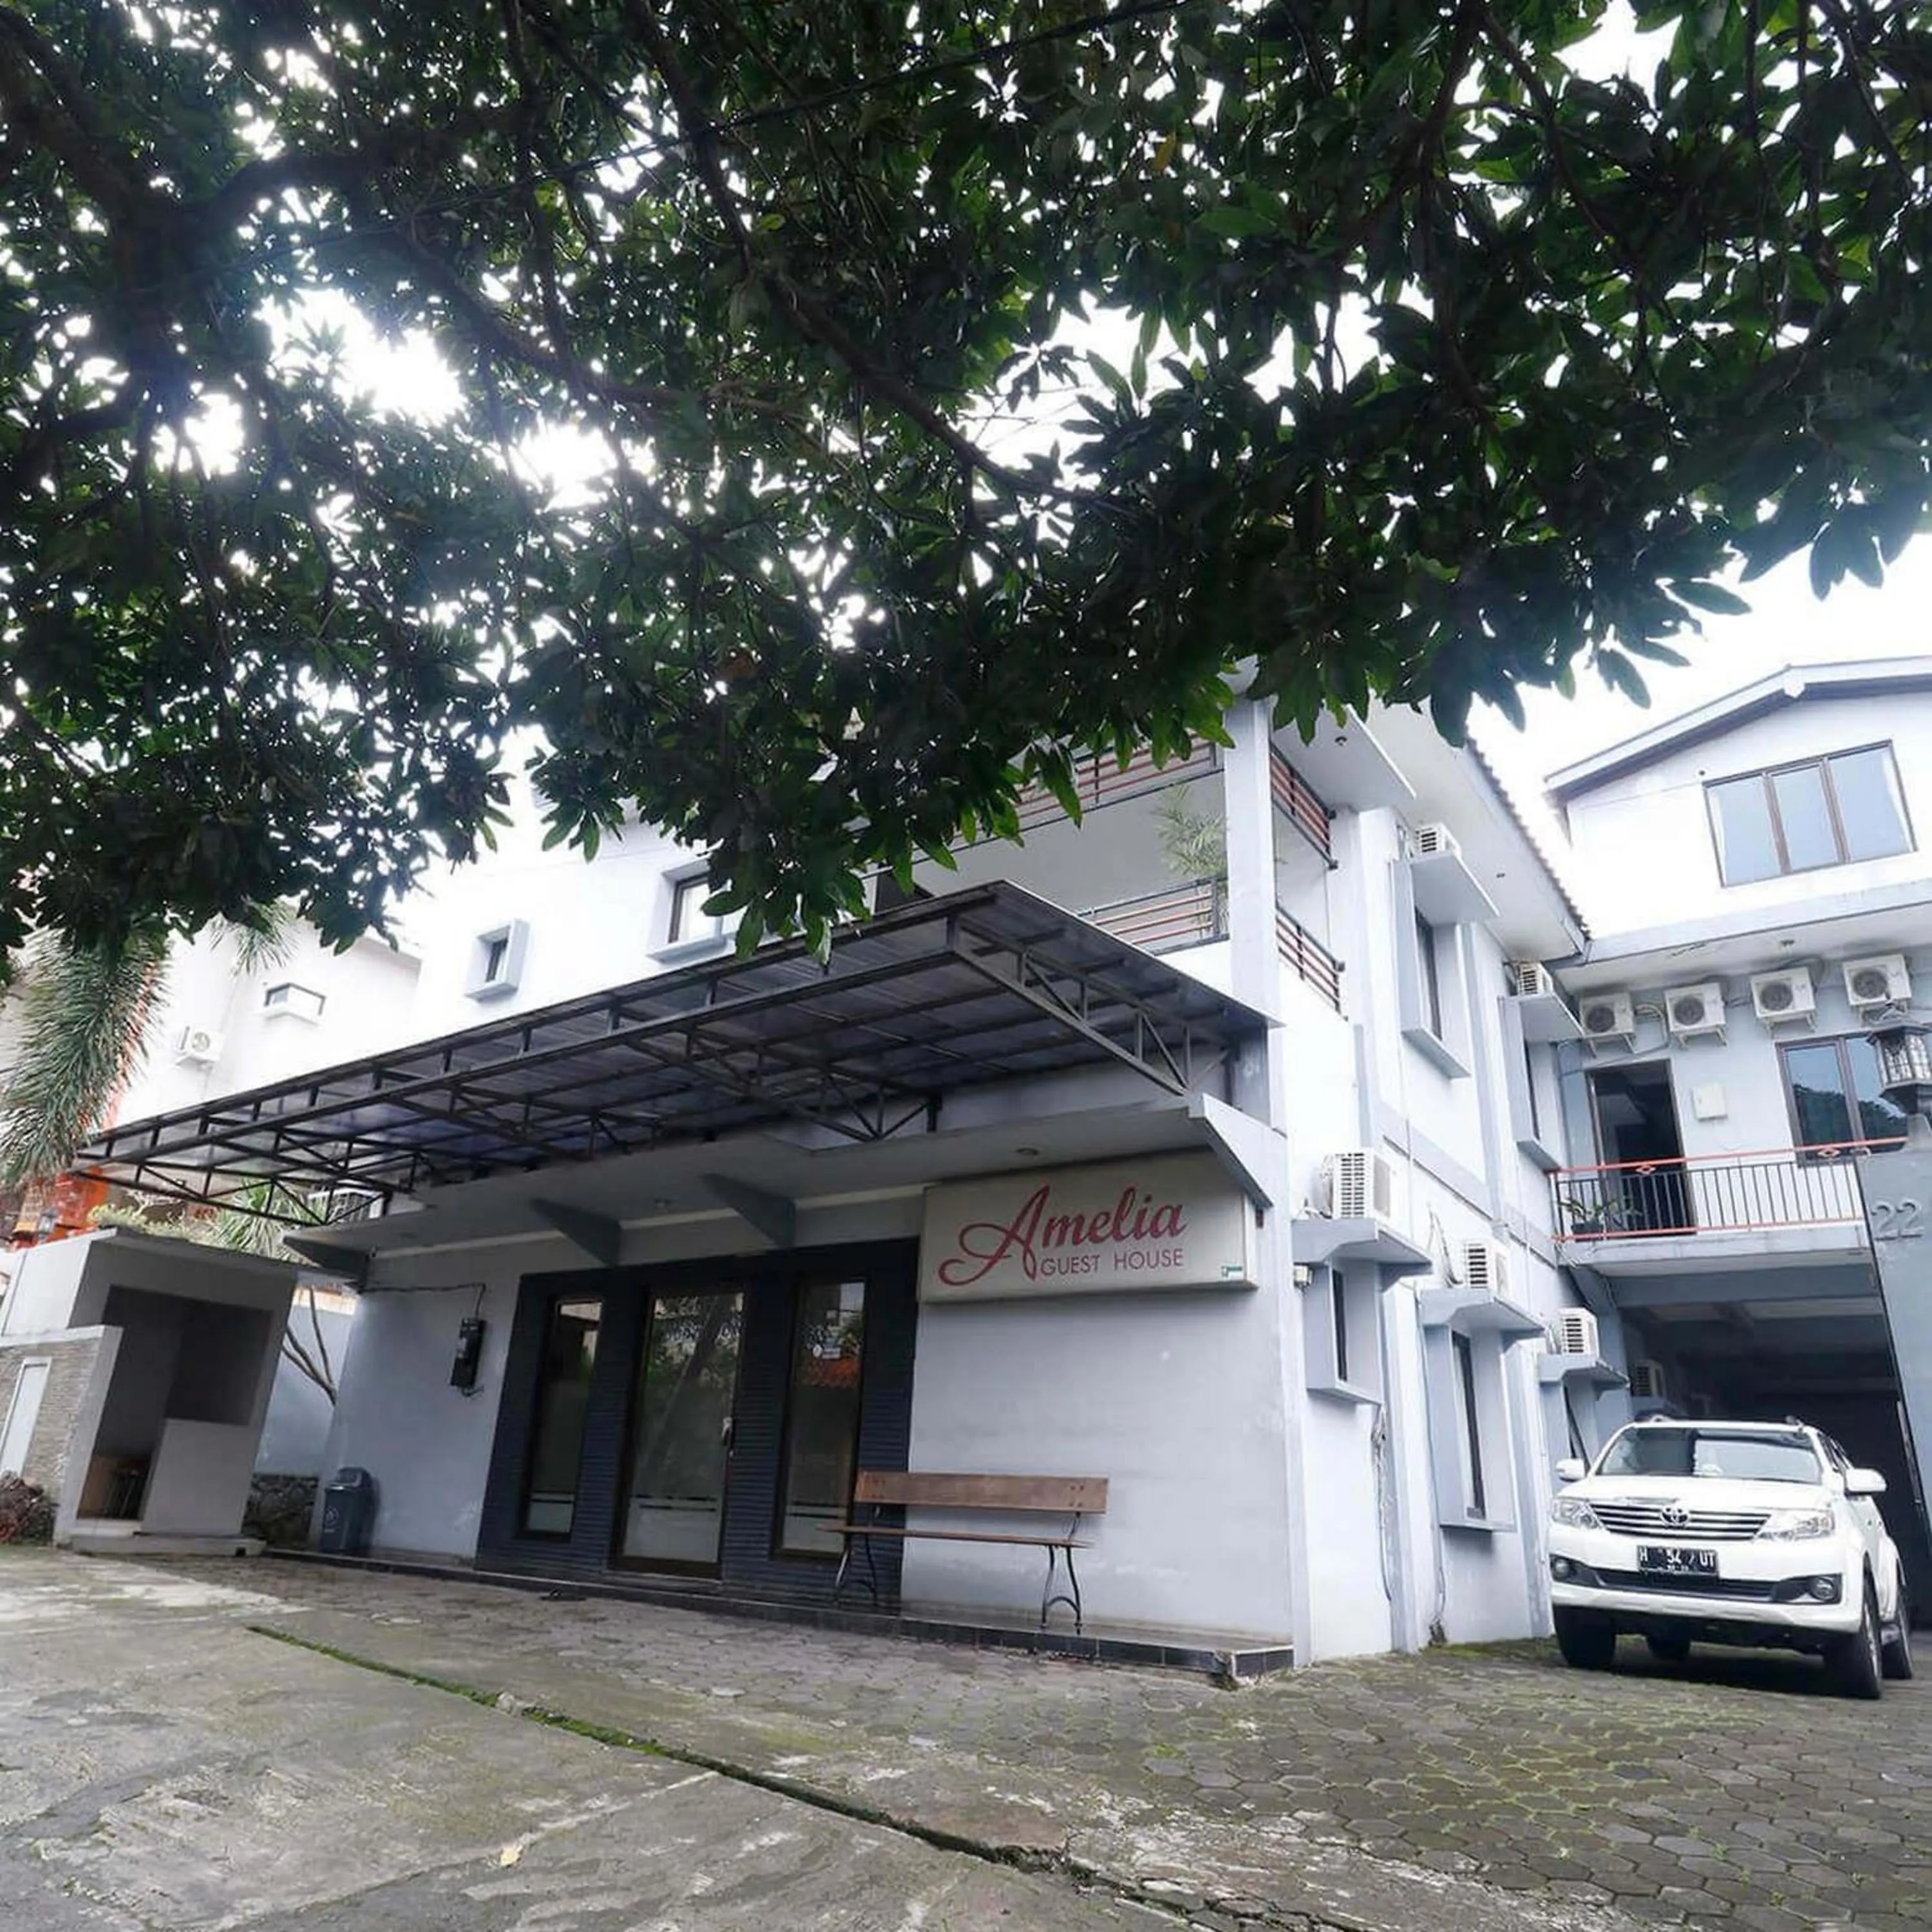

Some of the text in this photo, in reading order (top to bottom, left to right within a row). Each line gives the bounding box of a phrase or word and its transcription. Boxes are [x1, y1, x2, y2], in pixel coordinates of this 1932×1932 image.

[938, 1185, 1188, 1286] Amelia
[1870, 1198, 1925, 1241] 22
[1040, 1247, 1185, 1277] GUEST HOUSE
